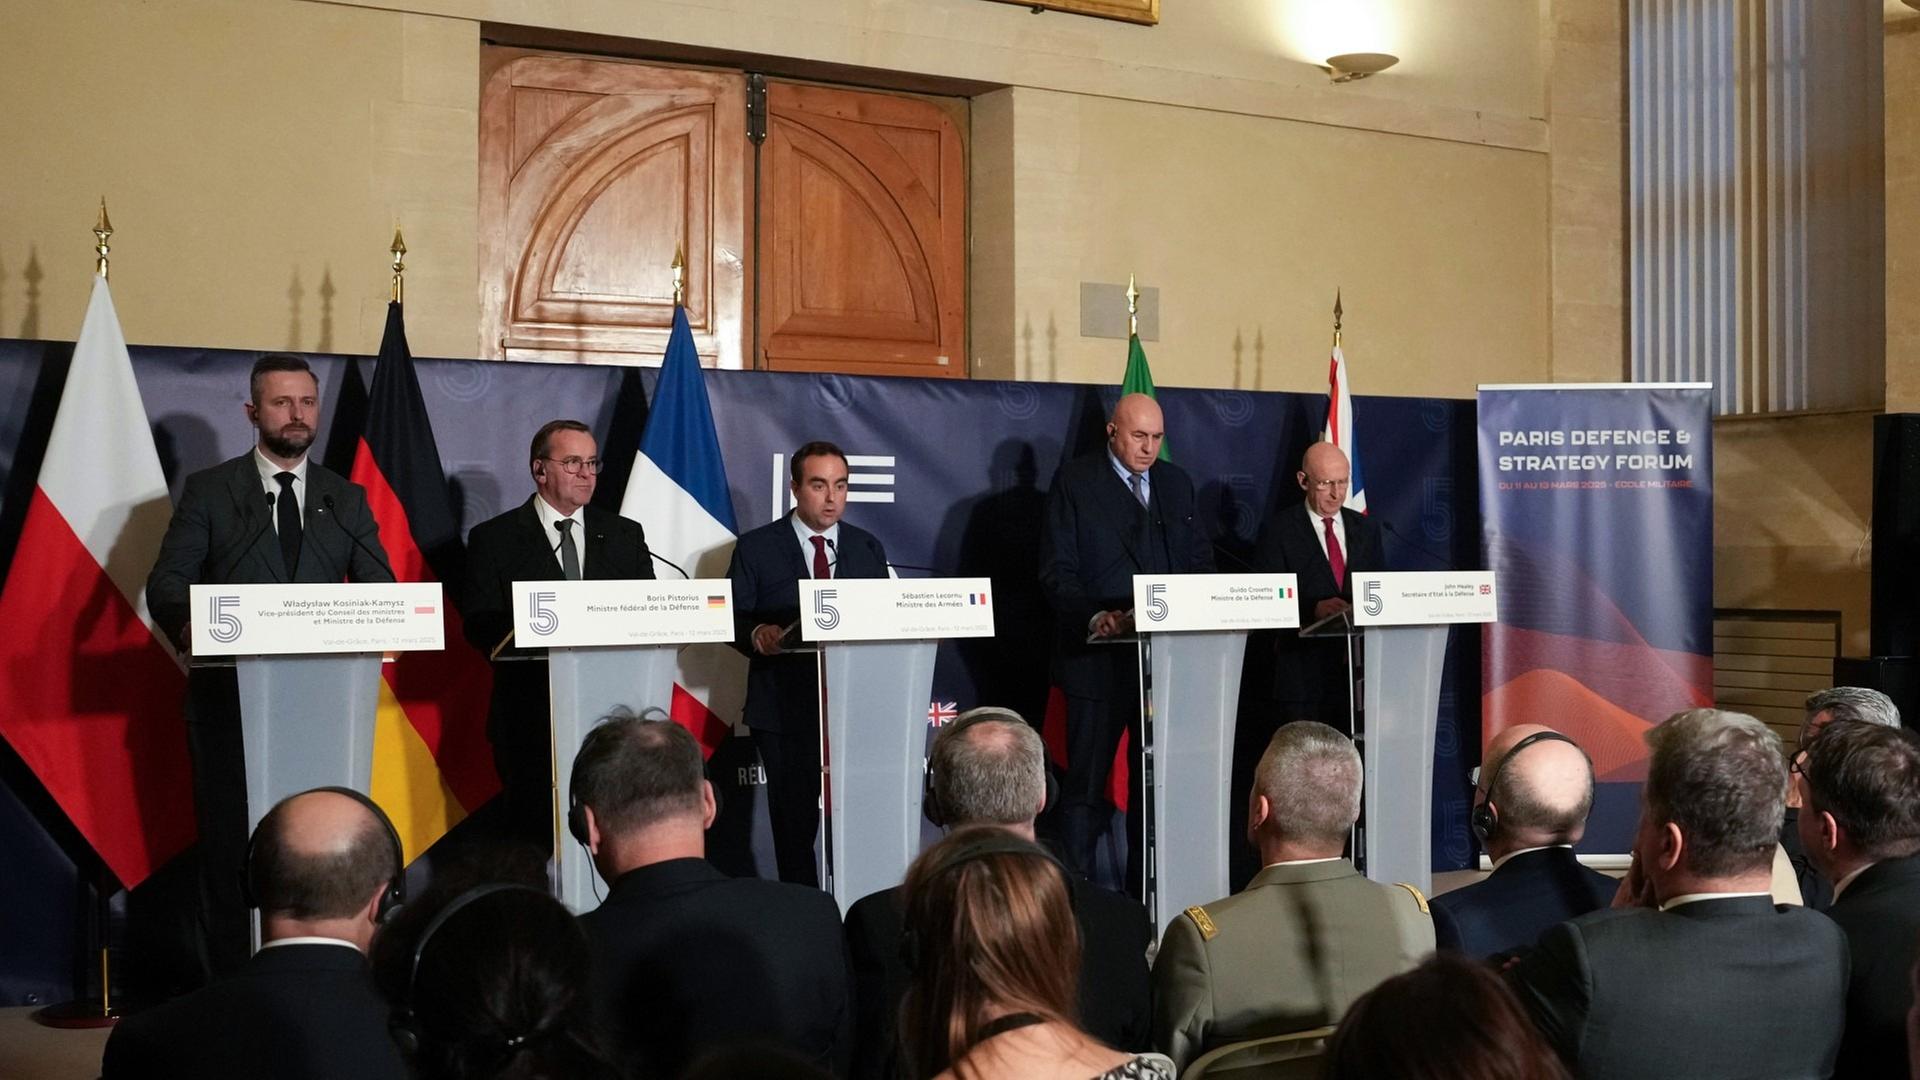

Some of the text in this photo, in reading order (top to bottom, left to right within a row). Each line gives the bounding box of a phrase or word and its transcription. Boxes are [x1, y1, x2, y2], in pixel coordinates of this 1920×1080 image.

[1499, 430, 1691, 446] PARIS DEFENCE &
[1499, 454, 1692, 470] STRATEGY FORUM
[1523, 481, 1537, 489] AU
[1550, 481, 1580, 489] MARS
[1647, 480, 1692, 488] MILITAIRE
[283, 599, 405, 608] Władysław Kosiniak-Kamysz
[814, 589, 840, 630] 5
[1146, 584, 1168, 622] 5
[1364, 581, 1383, 616] 5
[209, 596, 242, 643] 5
[258, 609, 314, 618] Vice-président
[530, 592, 559, 636] 5
